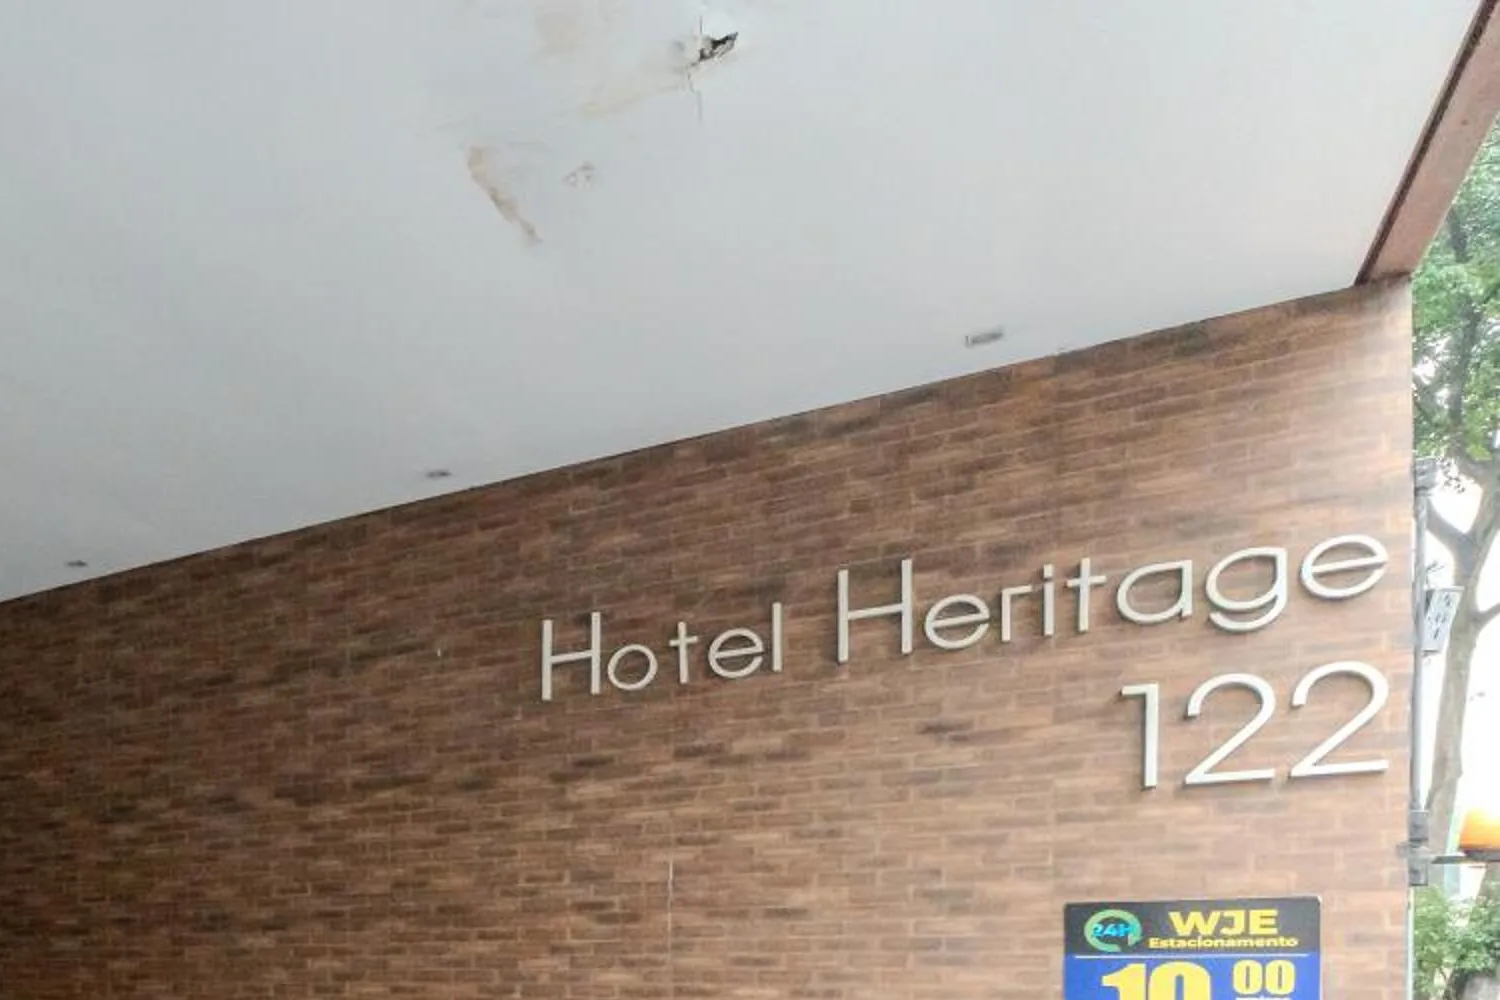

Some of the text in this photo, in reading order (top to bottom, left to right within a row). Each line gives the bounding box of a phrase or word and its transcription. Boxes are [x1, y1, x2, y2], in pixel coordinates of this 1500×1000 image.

[541, 533, 1390, 702] Hotel Heritage
[1120, 661, 1391, 789] 122
[1168, 909, 1279, 936] WJE
[1148, 933, 1299, 950] Estacionamento
[1232, 959, 1296, 996] 00
